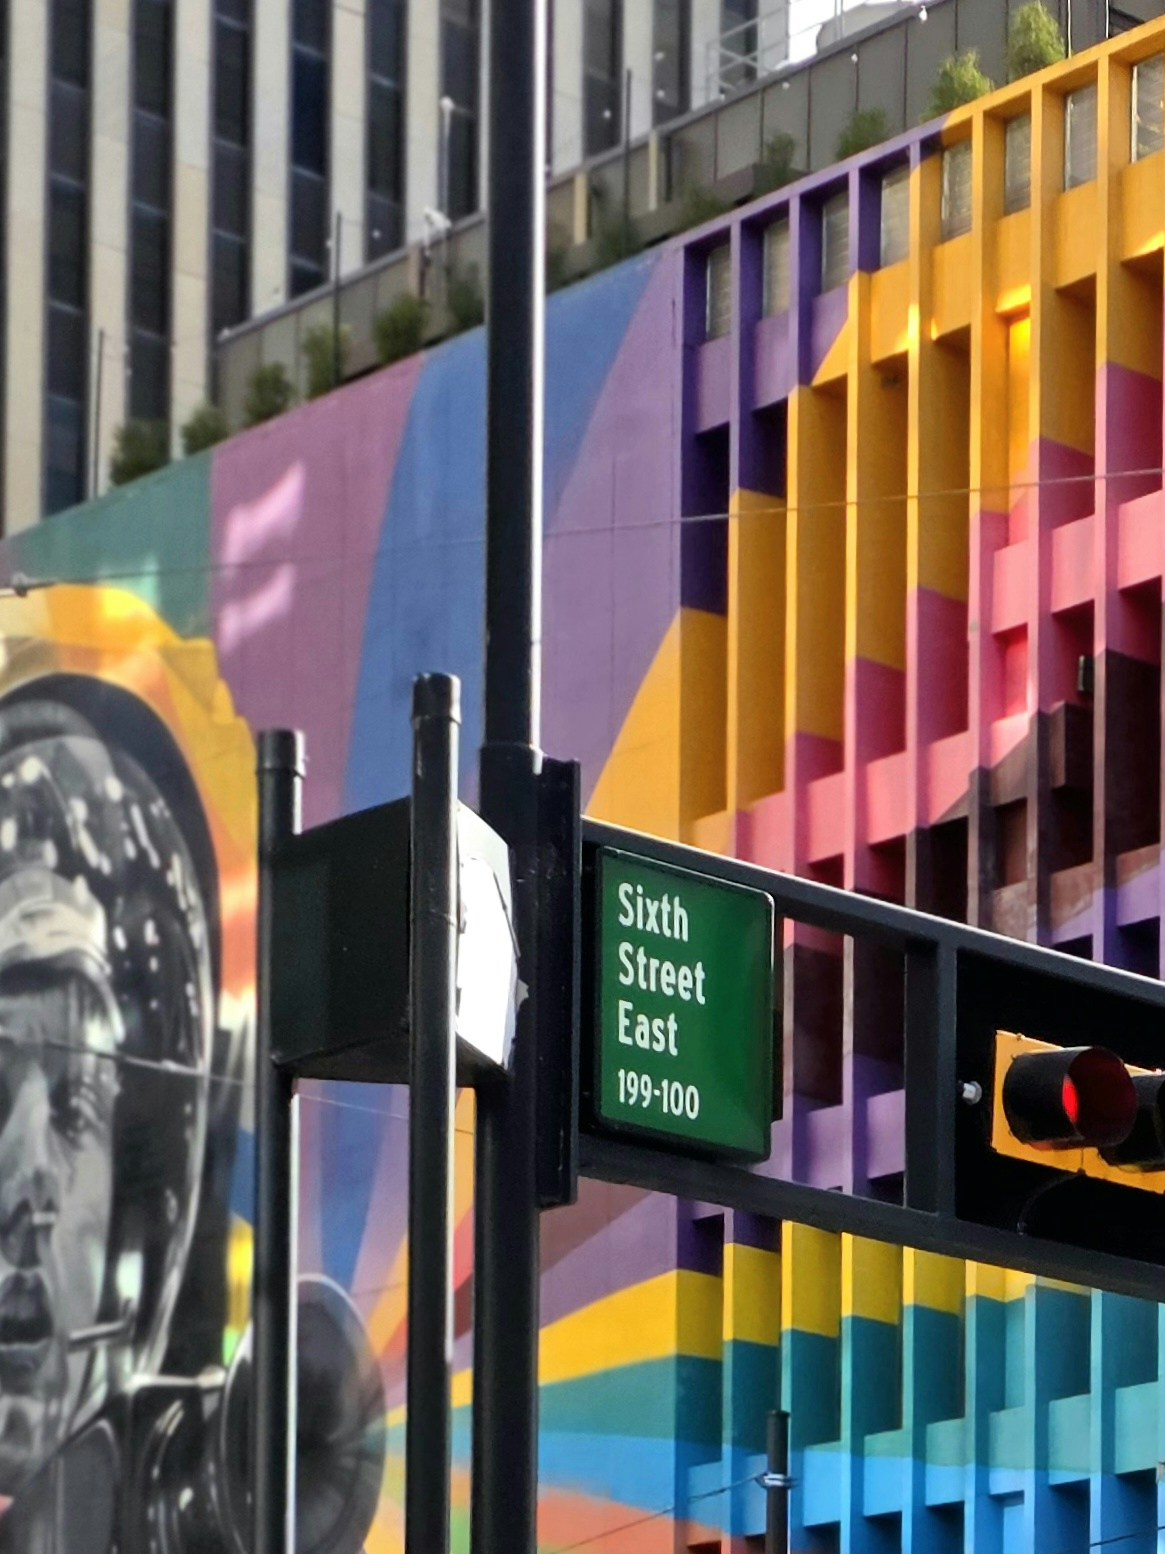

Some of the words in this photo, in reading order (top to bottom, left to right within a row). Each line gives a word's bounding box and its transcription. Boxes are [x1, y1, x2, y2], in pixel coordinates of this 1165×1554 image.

[618, 882, 689, 942] Sixth
[618, 942, 706, 1005] Street
[618, 999, 678, 1056] East
[618, 1068, 700, 1120] 199-100
